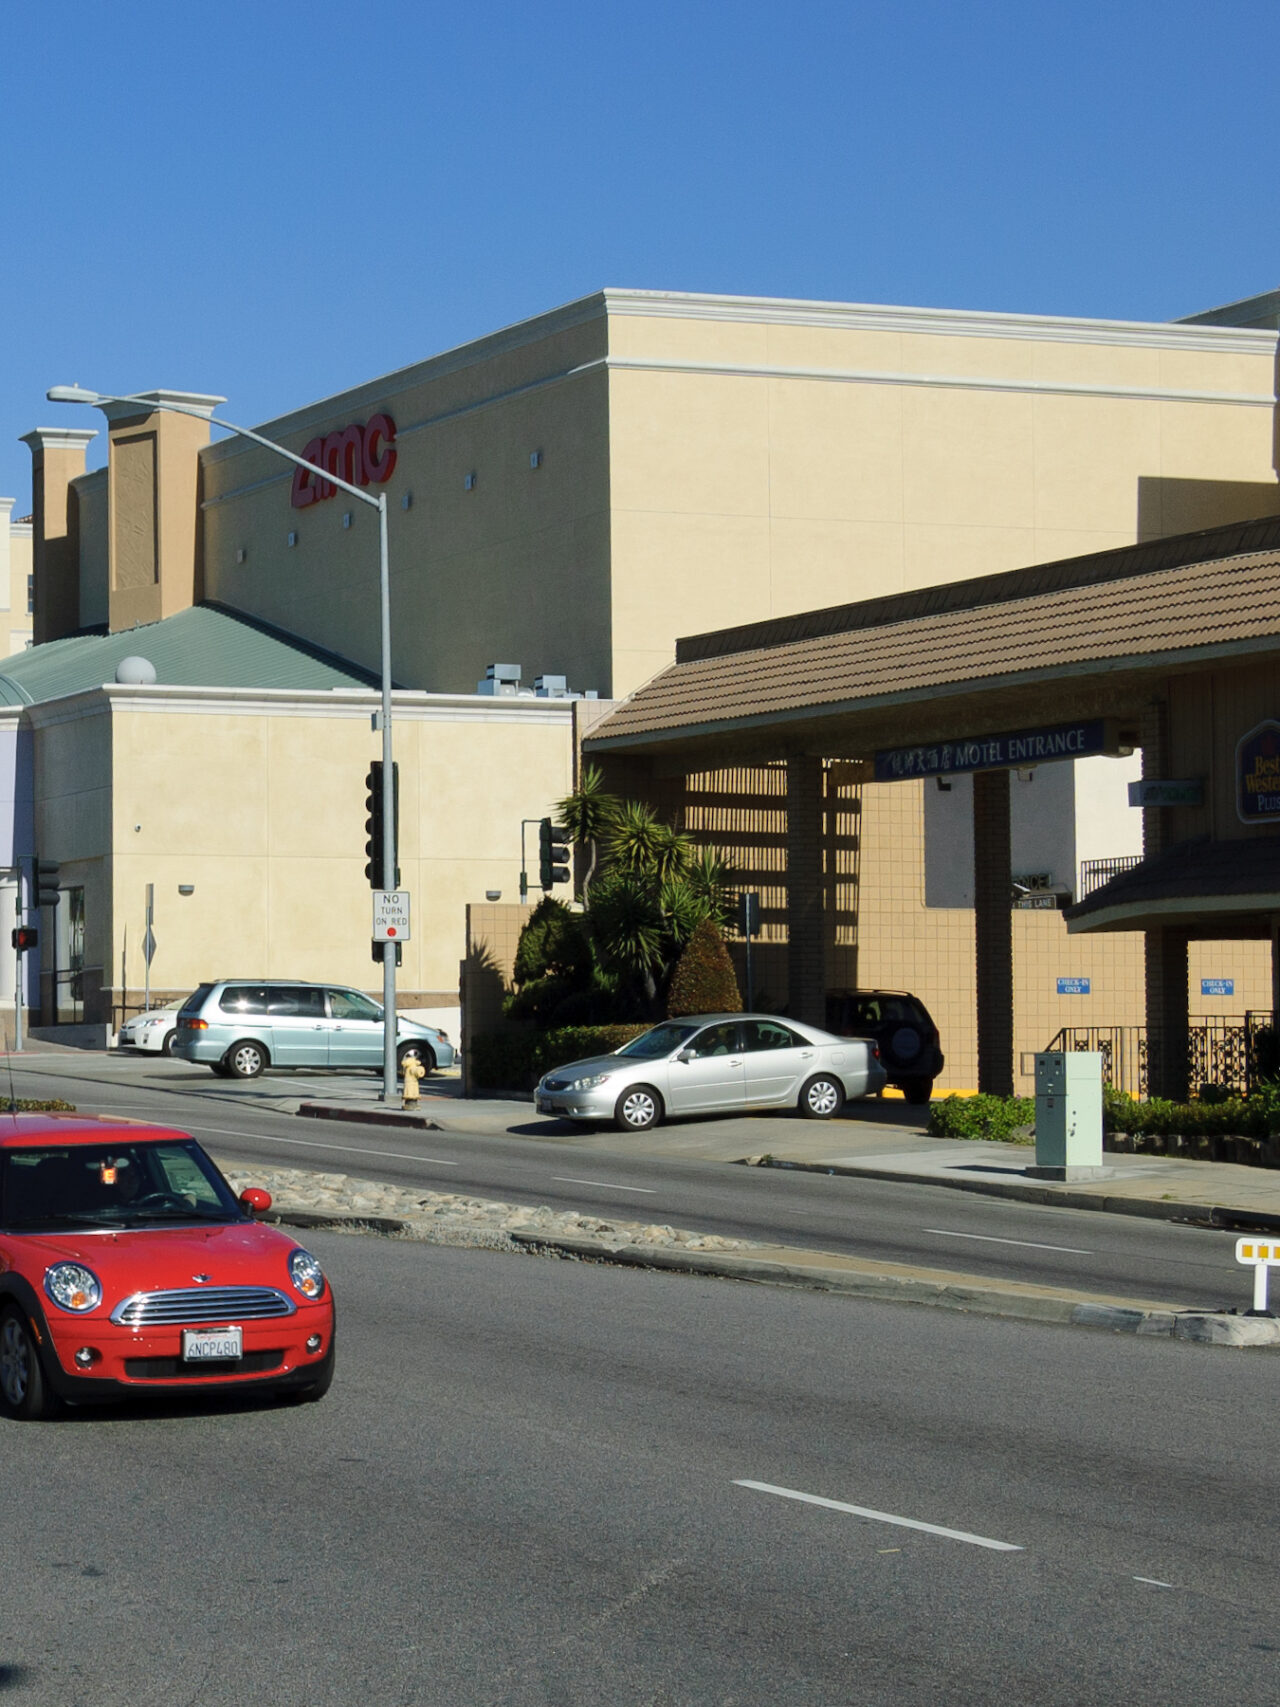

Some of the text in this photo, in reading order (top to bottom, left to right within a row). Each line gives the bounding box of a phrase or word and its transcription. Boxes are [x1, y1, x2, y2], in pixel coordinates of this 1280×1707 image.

[955, 730, 1085, 766] MOTEL ENTRANCE
[383, 894, 400, 904] NO
[381, 906, 403, 915] TURN
[376, 917, 408, 925] ON RED
[188, 1340, 238, 1358] 6NCP480
